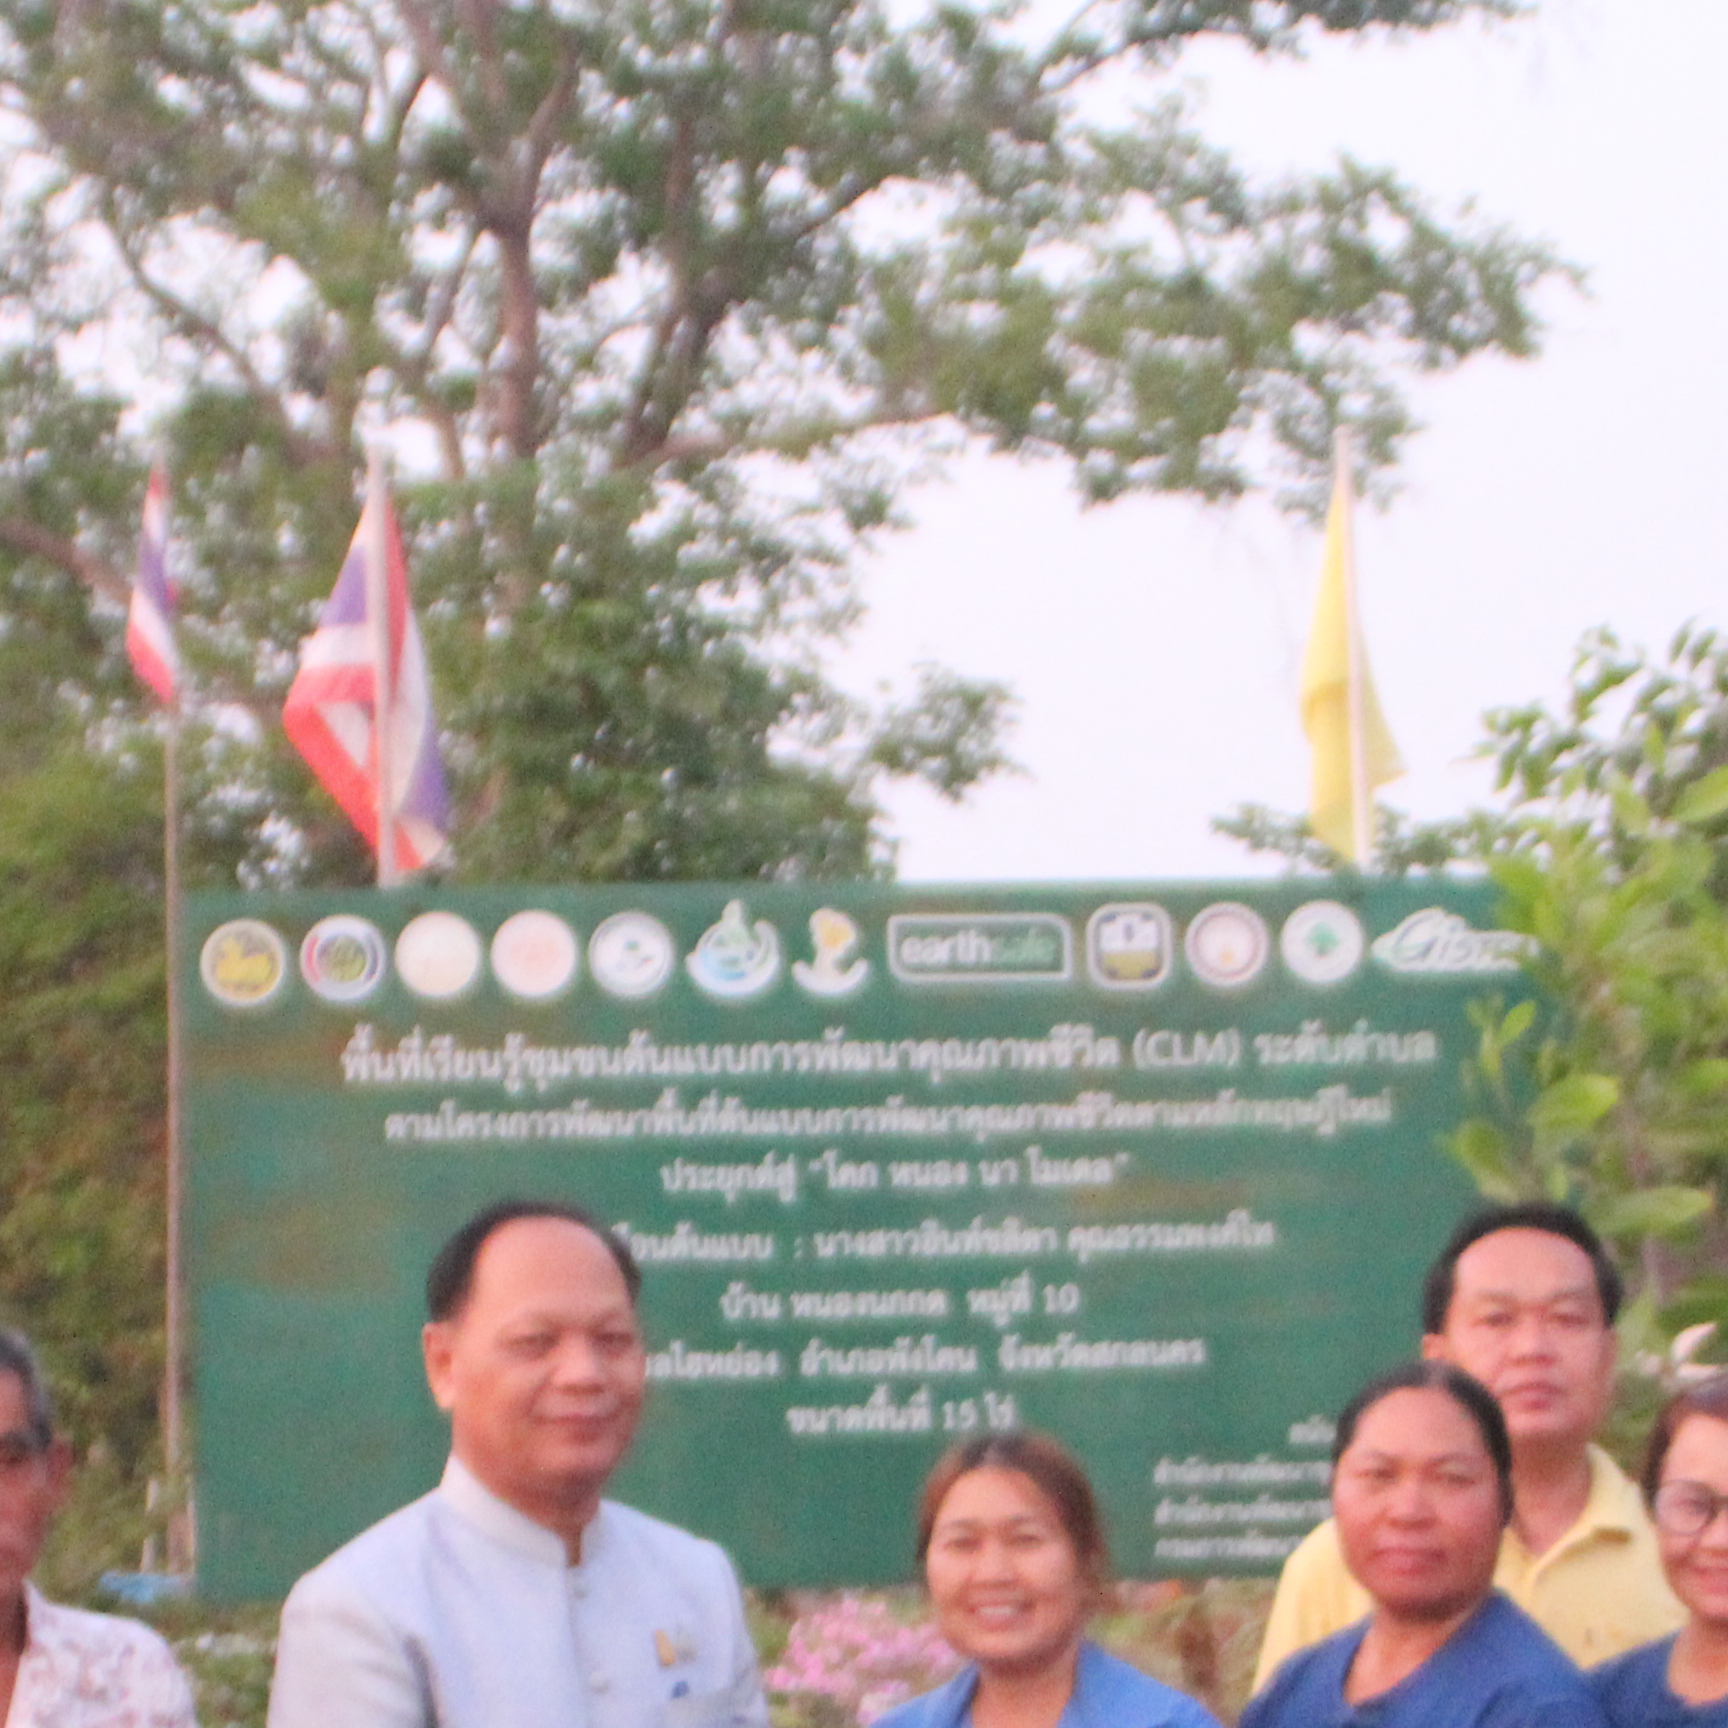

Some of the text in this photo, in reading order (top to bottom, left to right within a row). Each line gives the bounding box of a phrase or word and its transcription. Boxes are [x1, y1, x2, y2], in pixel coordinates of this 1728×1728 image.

[1131, 1029, 1242, 1071] (CLM)
[1253, 1019, 1436, 1067] ระดับตำบล
[661, 1152, 799, 1203] ประยุกต์สู่
[889, 1160, 970, 1192] หนอง
[979, 1159, 1019, 1187] นา
[720, 1281, 784, 1321] บ้าน
[967, 1271, 1033, 1328] หมู่ที่
[1044, 1283, 1081, 1314] 10
[786, 1384, 933, 1435] ขนาดพื้นที่
